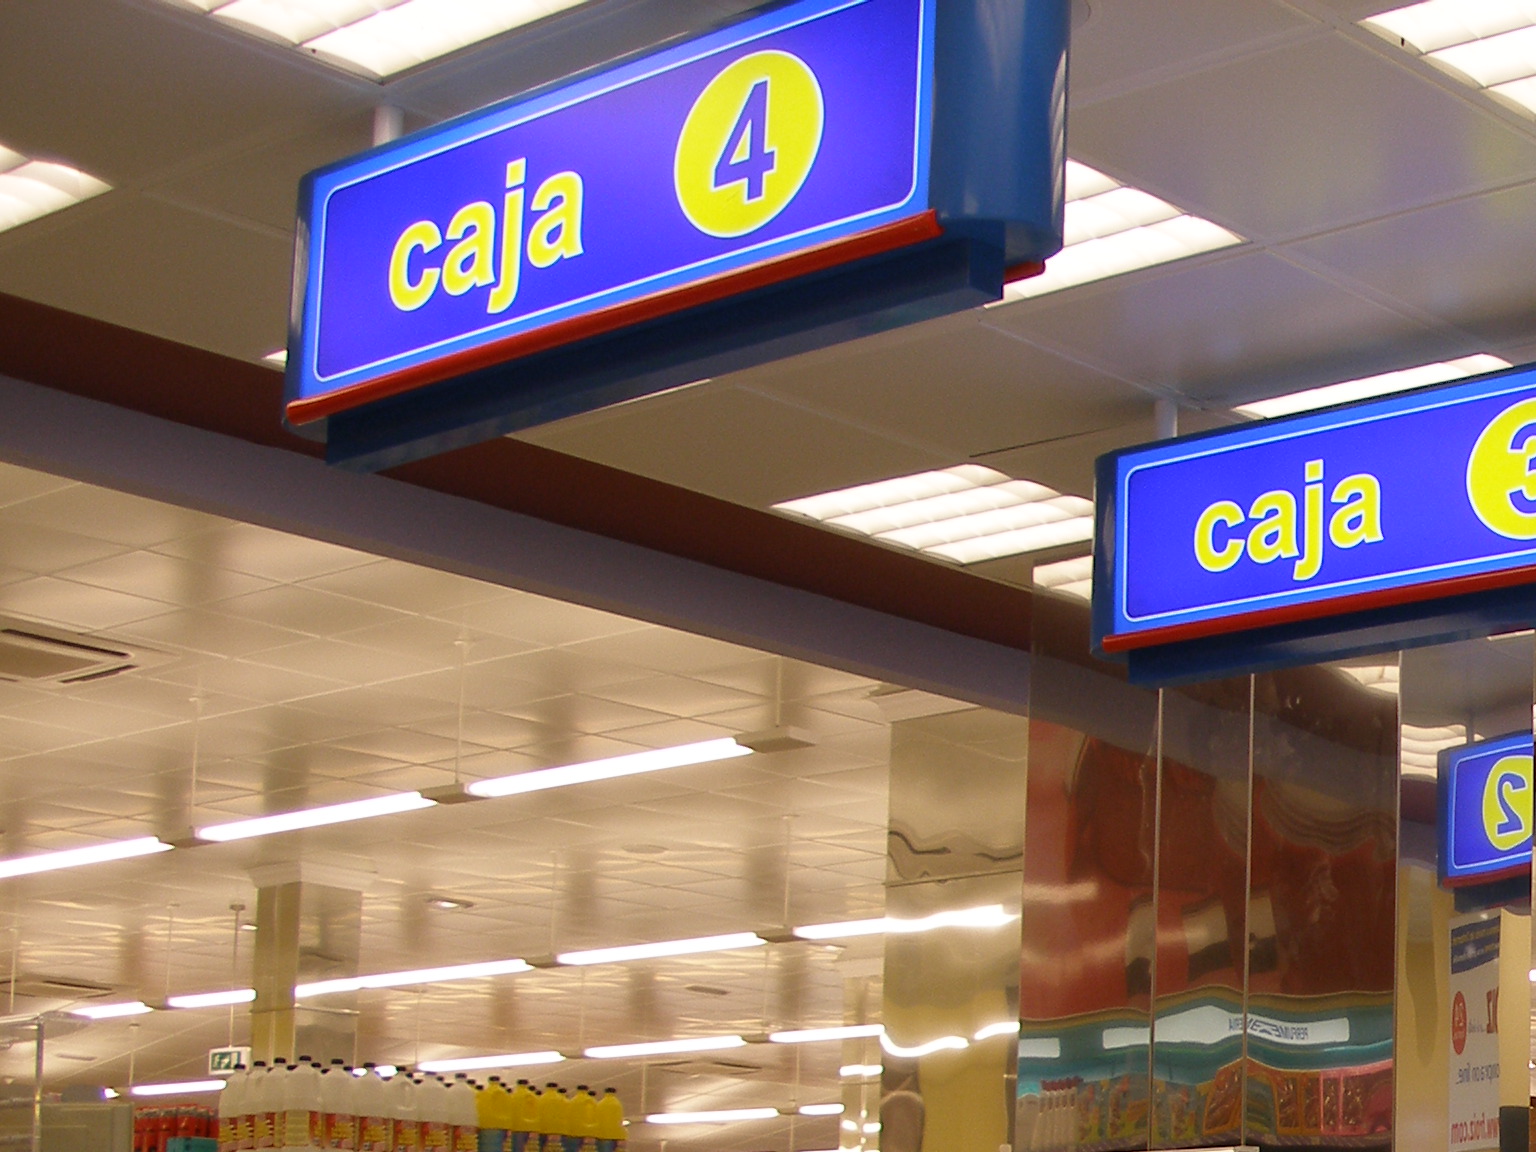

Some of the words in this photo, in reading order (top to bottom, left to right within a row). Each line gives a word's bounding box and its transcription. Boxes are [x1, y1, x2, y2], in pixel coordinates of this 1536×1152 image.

[389, 157, 585, 314] caja
[711, 78, 777, 204] 4
[1194, 459, 1384, 580] caja
